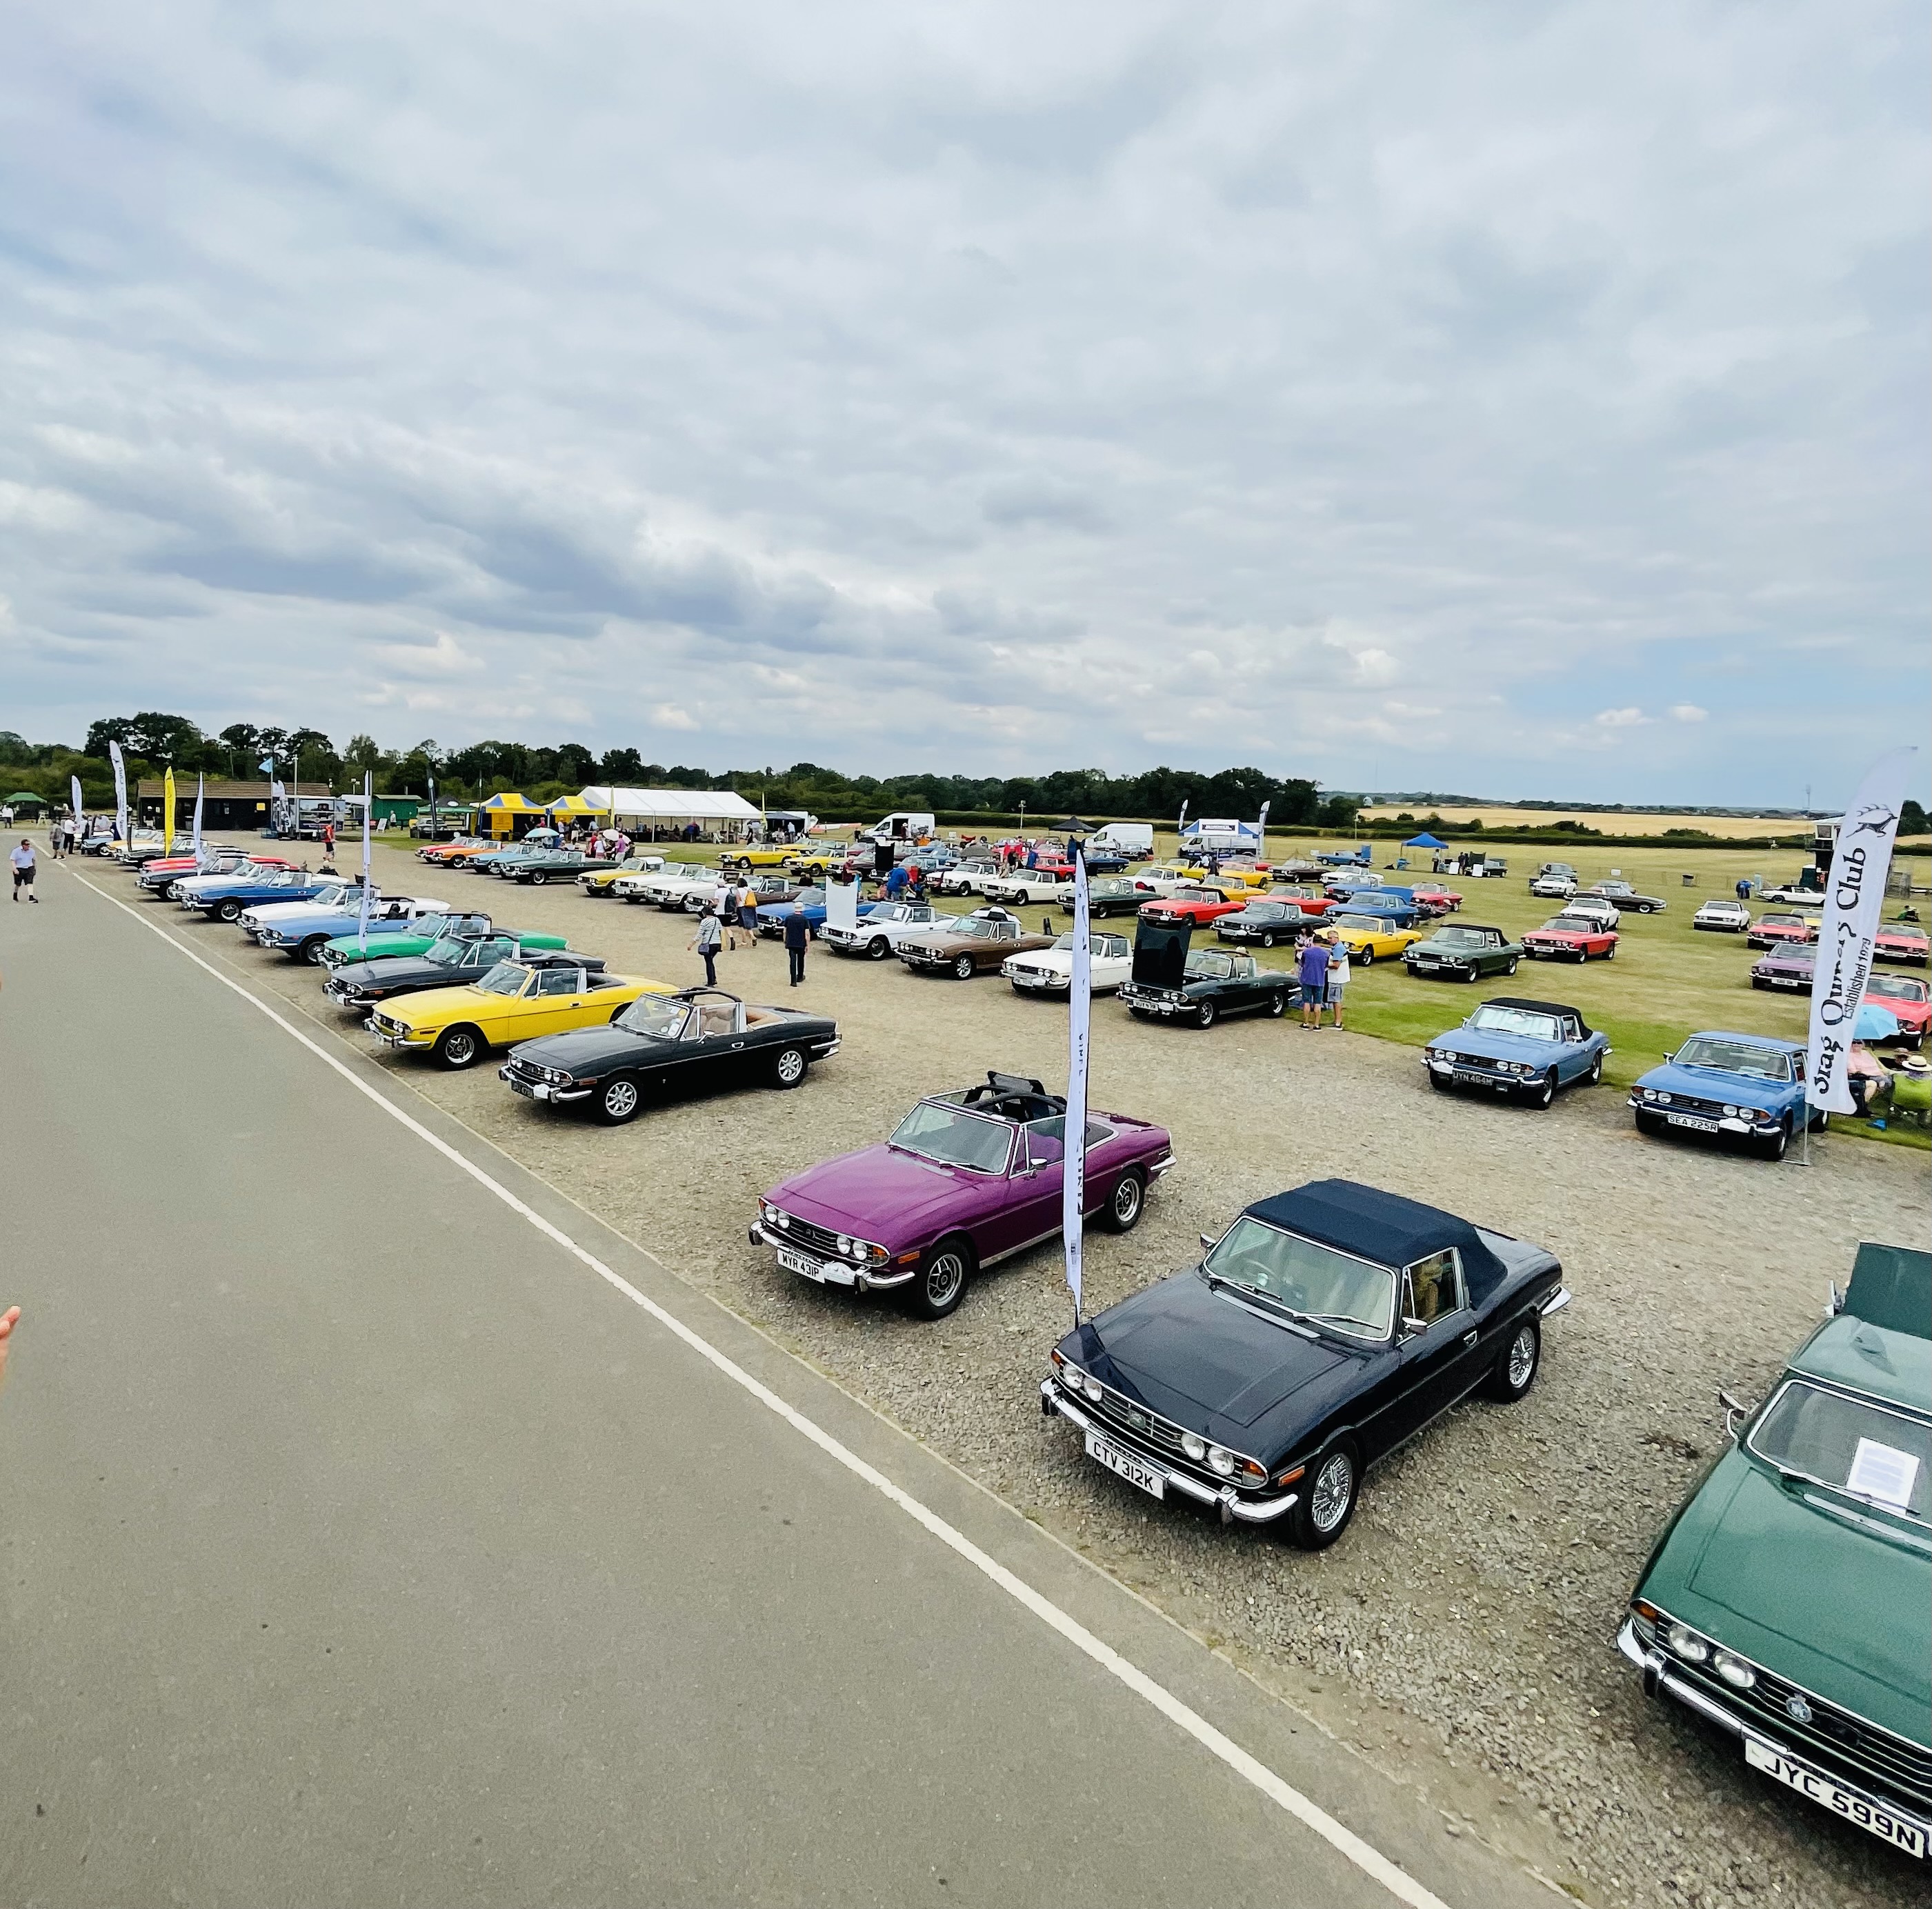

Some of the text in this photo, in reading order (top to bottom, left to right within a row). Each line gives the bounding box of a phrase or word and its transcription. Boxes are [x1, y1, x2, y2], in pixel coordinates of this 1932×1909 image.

[1836, 848, 1866, 910] Club
[1842, 937, 1871, 1020] Established 1979
[1669, 1115, 1717, 1131] SEA 225R
[1094, 1441, 1153, 1491] CTV 312K
[1764, 1758, 1916, 1850] JYC 599N
